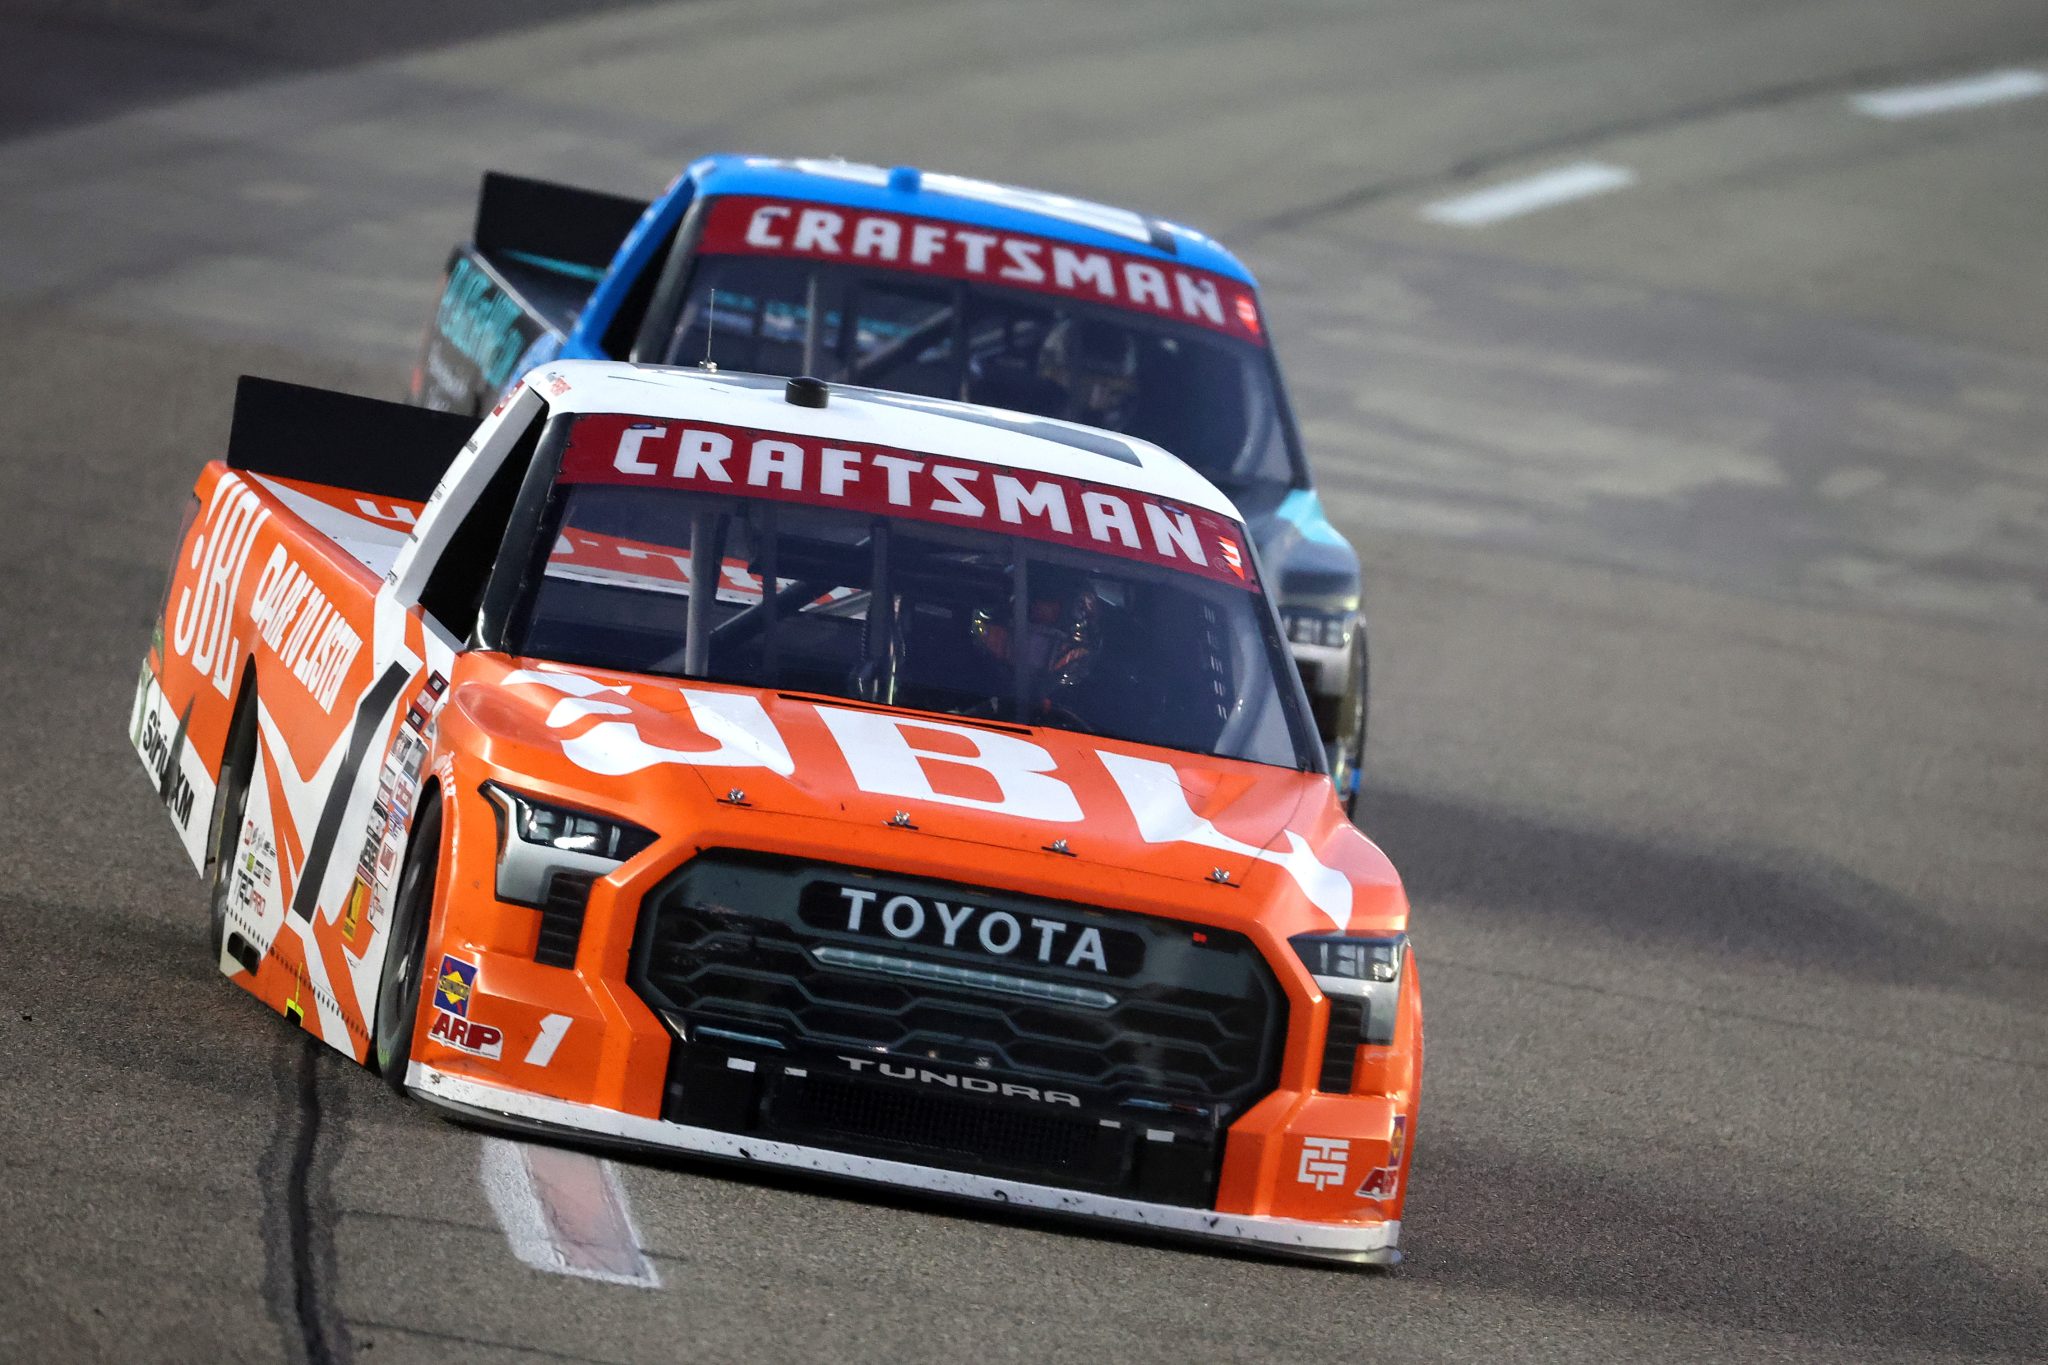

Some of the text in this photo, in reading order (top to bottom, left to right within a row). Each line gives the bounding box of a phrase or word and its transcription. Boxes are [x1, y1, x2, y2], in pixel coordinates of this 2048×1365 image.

[744, 206, 1226, 325] CRAFTSMAN
[612, 426, 1209, 567] CRAFTSMAN
[249, 542, 364, 715] DARE TO LISTEN
[142, 709, 195, 832] SiriuXM
[501, 669, 1354, 931] JBL
[840, 887, 1108, 972] TOYOTA
[431, 1012, 502, 1051] ARP
[523, 1013, 574, 1067] 1
[838, 1055, 1081, 1107] TUNDRA
